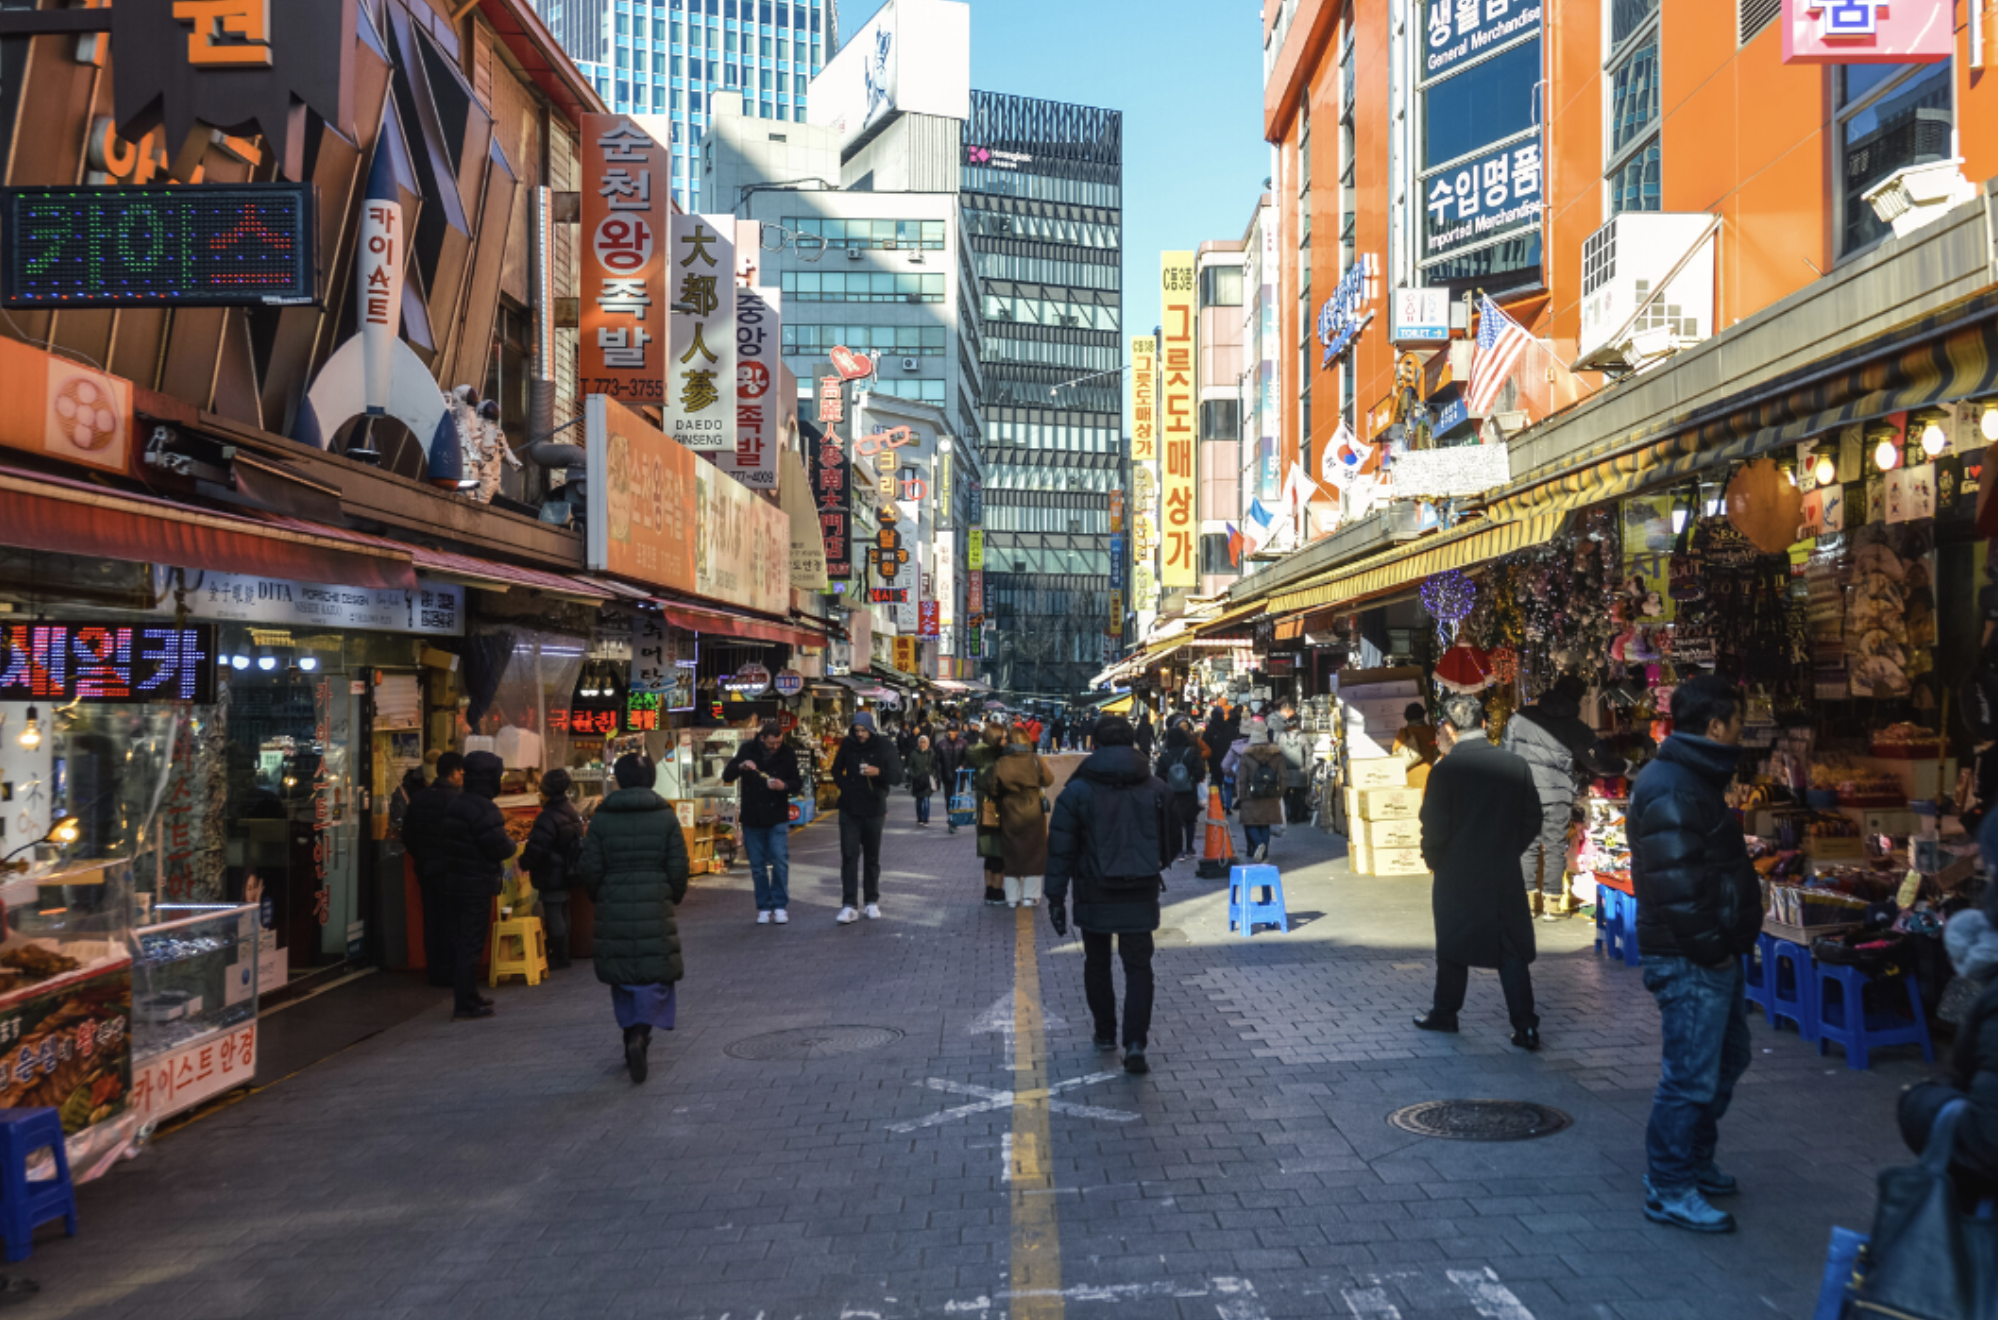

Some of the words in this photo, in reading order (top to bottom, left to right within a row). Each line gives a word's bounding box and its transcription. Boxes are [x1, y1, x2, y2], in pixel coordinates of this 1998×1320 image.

[1428, 38, 1468, 70] General
[1428, 143, 1540, 226] 수입명품
[594, 120, 655, 367] 순천왕족발
[1428, 219, 1472, 250] Imported
[367, 207, 395, 325] 카이스트
[1400, 329, 1431, 339] TOILET
[676, 420, 723, 431] DAEDO
[1135, 356, 1153, 455] 그릇도매상가
[674, 434, 723, 446] GINSENG
[1166, 304, 1193, 570] 그릇도매상가
[258, 581, 293, 602] DITA
[302, 588, 340, 602] PORSCHE
[341, 593, 369, 606] DESIGN
[313, 676, 333, 926] 카이스트안경
[133, 1046, 213, 1111] 카이스트
[219, 1027, 254, 1073] 안경
